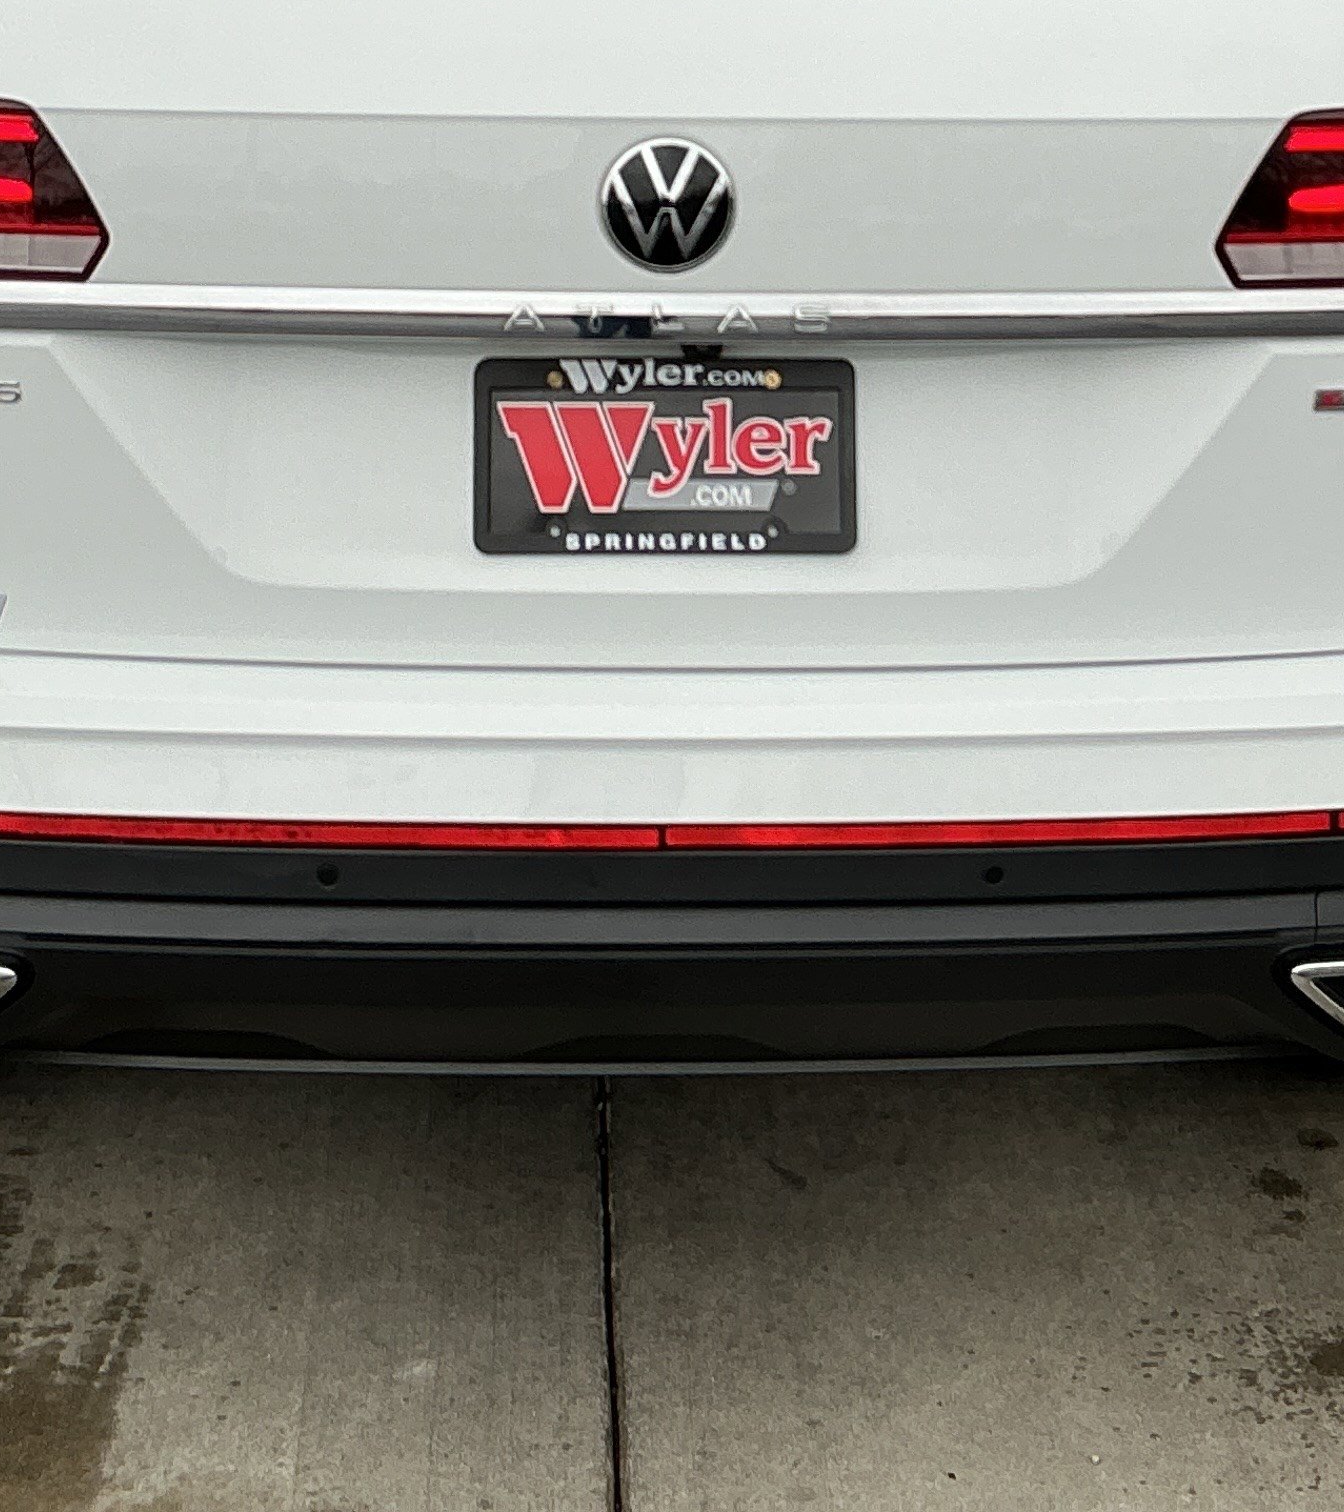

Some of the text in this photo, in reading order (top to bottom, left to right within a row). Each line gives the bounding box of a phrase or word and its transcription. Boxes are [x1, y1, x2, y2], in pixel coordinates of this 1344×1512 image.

[601, 137, 733, 270] VW
[503, 302, 831, 334] ATLAS
[496, 397, 833, 515] Wyler
[689, 484, 753, 507] .COM
[564, 532, 768, 552] SPRINGFIELD
